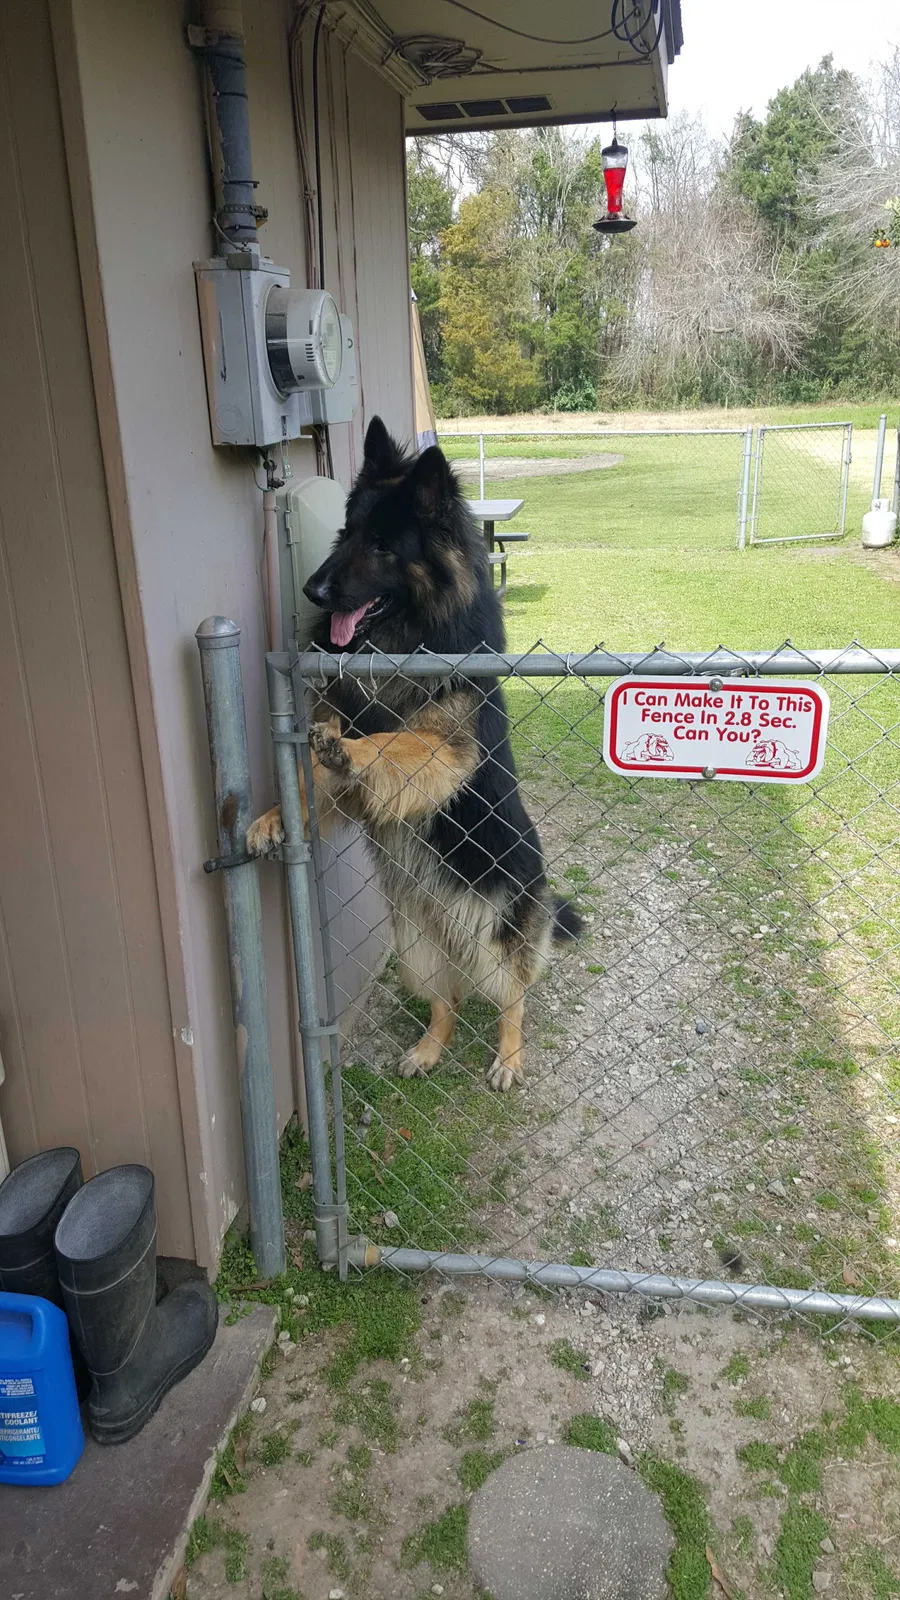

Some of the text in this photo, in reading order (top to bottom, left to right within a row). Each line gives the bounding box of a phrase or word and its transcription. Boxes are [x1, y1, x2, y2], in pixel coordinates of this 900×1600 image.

[623, 691, 812, 713] I Can Make It To This
[641, 708, 796, 729] Fence In 2.8 Sec.
[673, 726, 761, 744] Can You?
[4, 1417, 38, 1425] COOLANT
